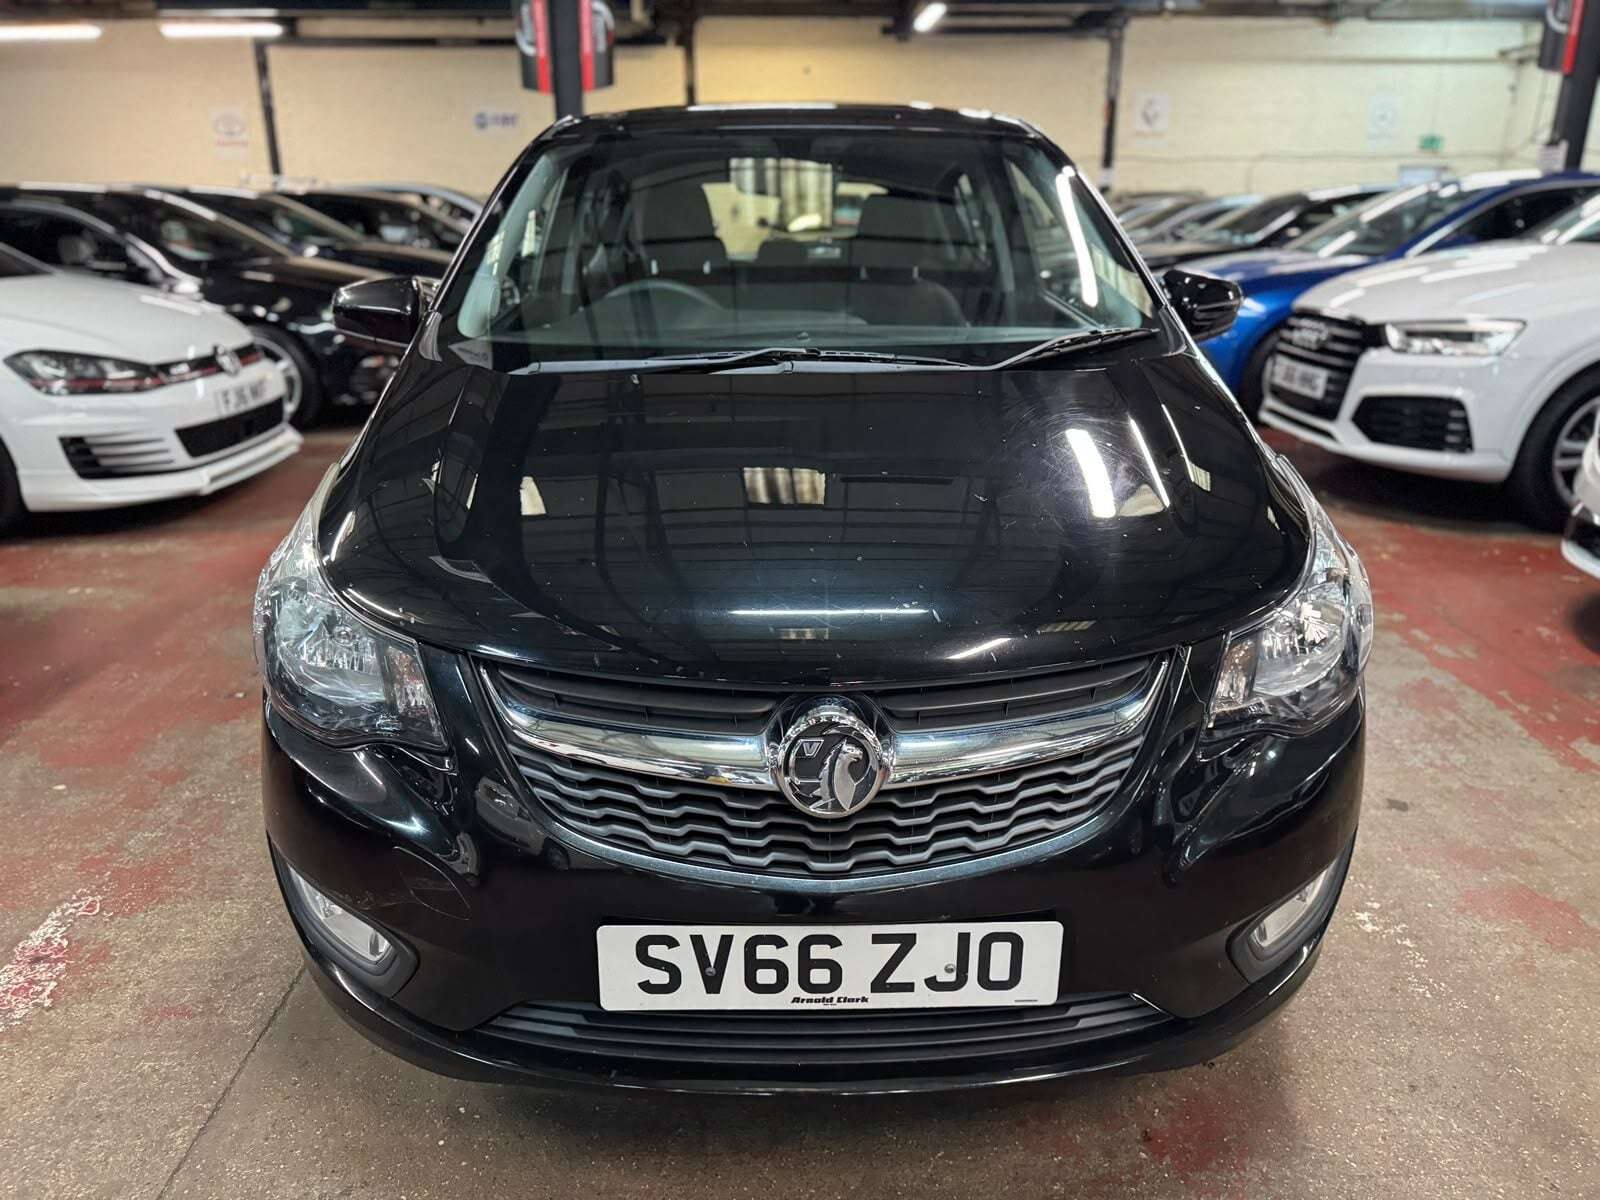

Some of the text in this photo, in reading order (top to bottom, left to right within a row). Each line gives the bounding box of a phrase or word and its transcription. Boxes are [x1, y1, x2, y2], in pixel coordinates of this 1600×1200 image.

[635, 931, 1024, 995] SV66 ZJO
[791, 996, 834, 1004] Arnold
